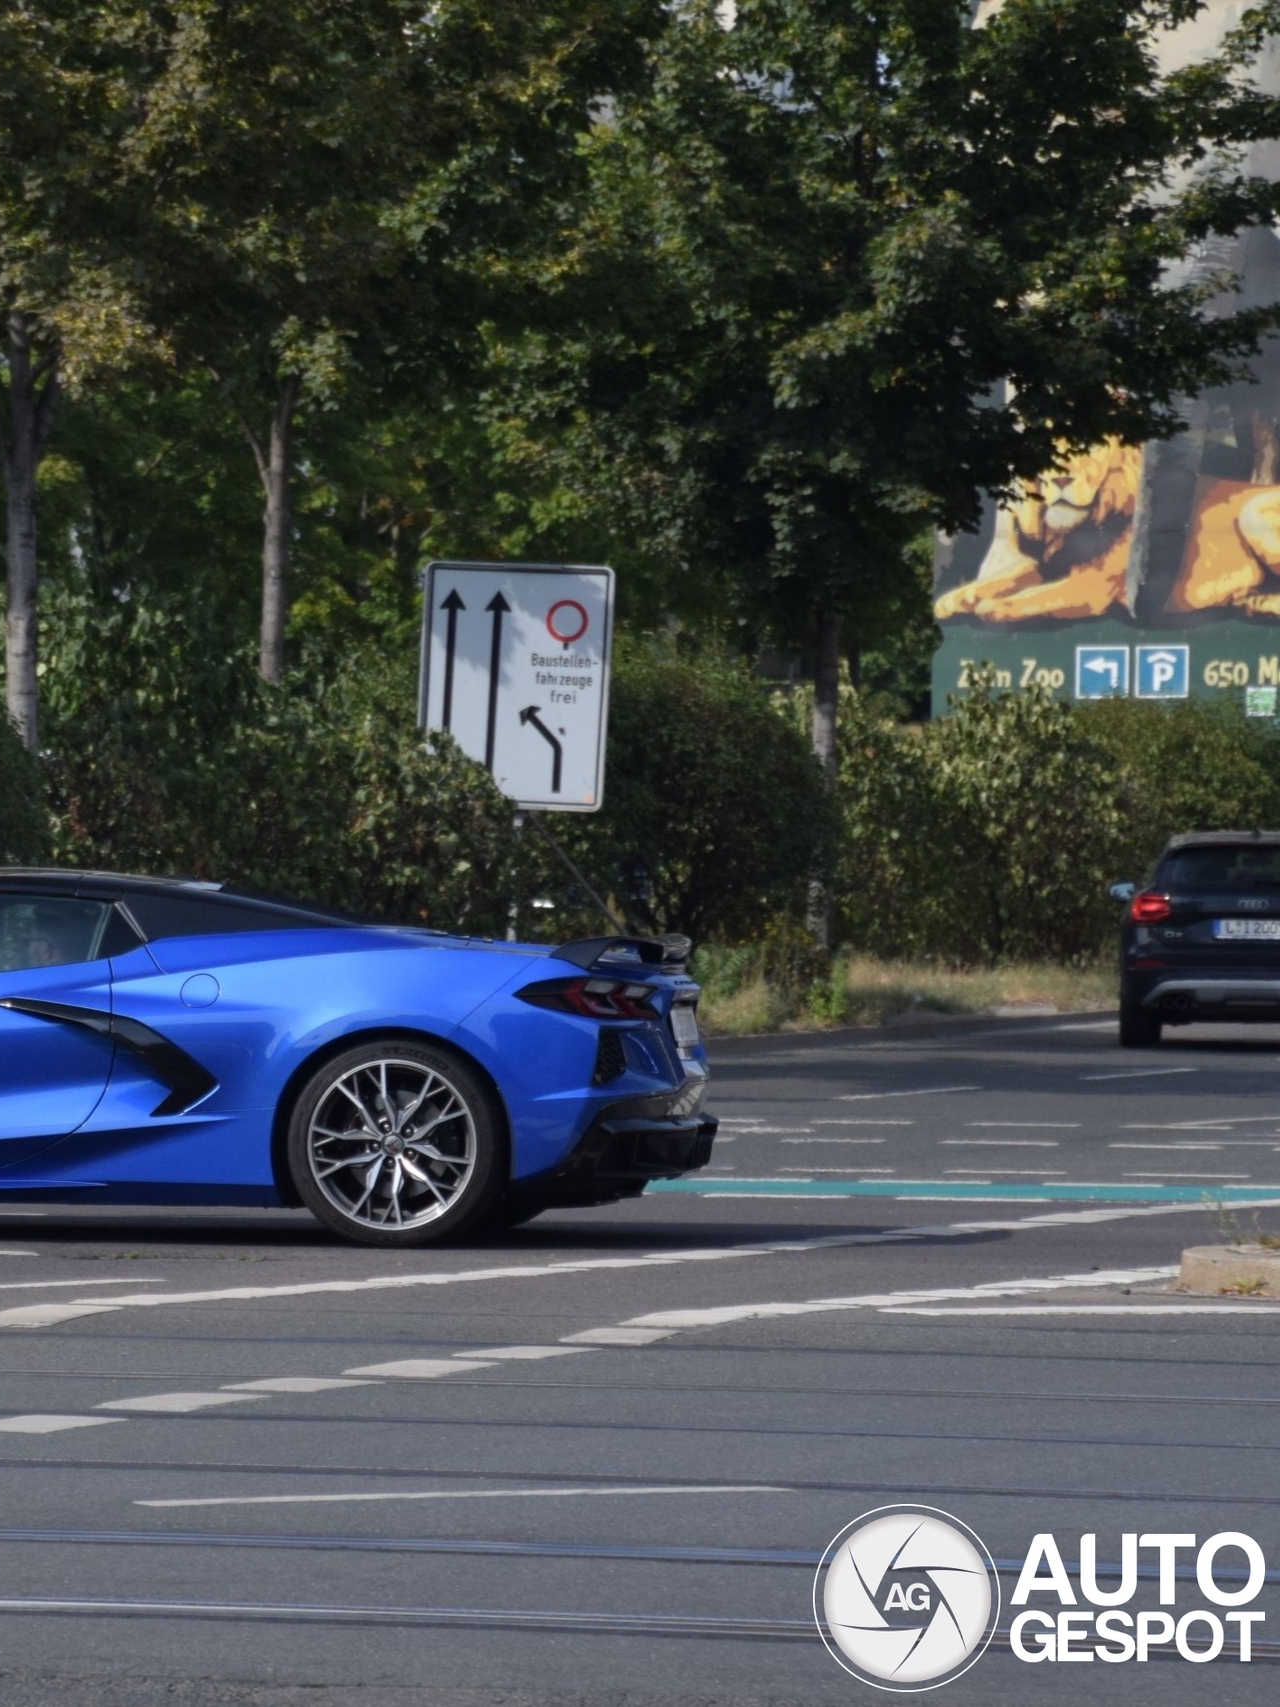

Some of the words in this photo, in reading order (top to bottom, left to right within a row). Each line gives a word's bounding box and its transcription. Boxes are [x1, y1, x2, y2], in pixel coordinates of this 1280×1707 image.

[531, 652, 598, 668] Baustellen-
[1019, 658, 1065, 688] Zoo
[1204, 660, 1249, 687] 650
[550, 689, 577, 704] frei
